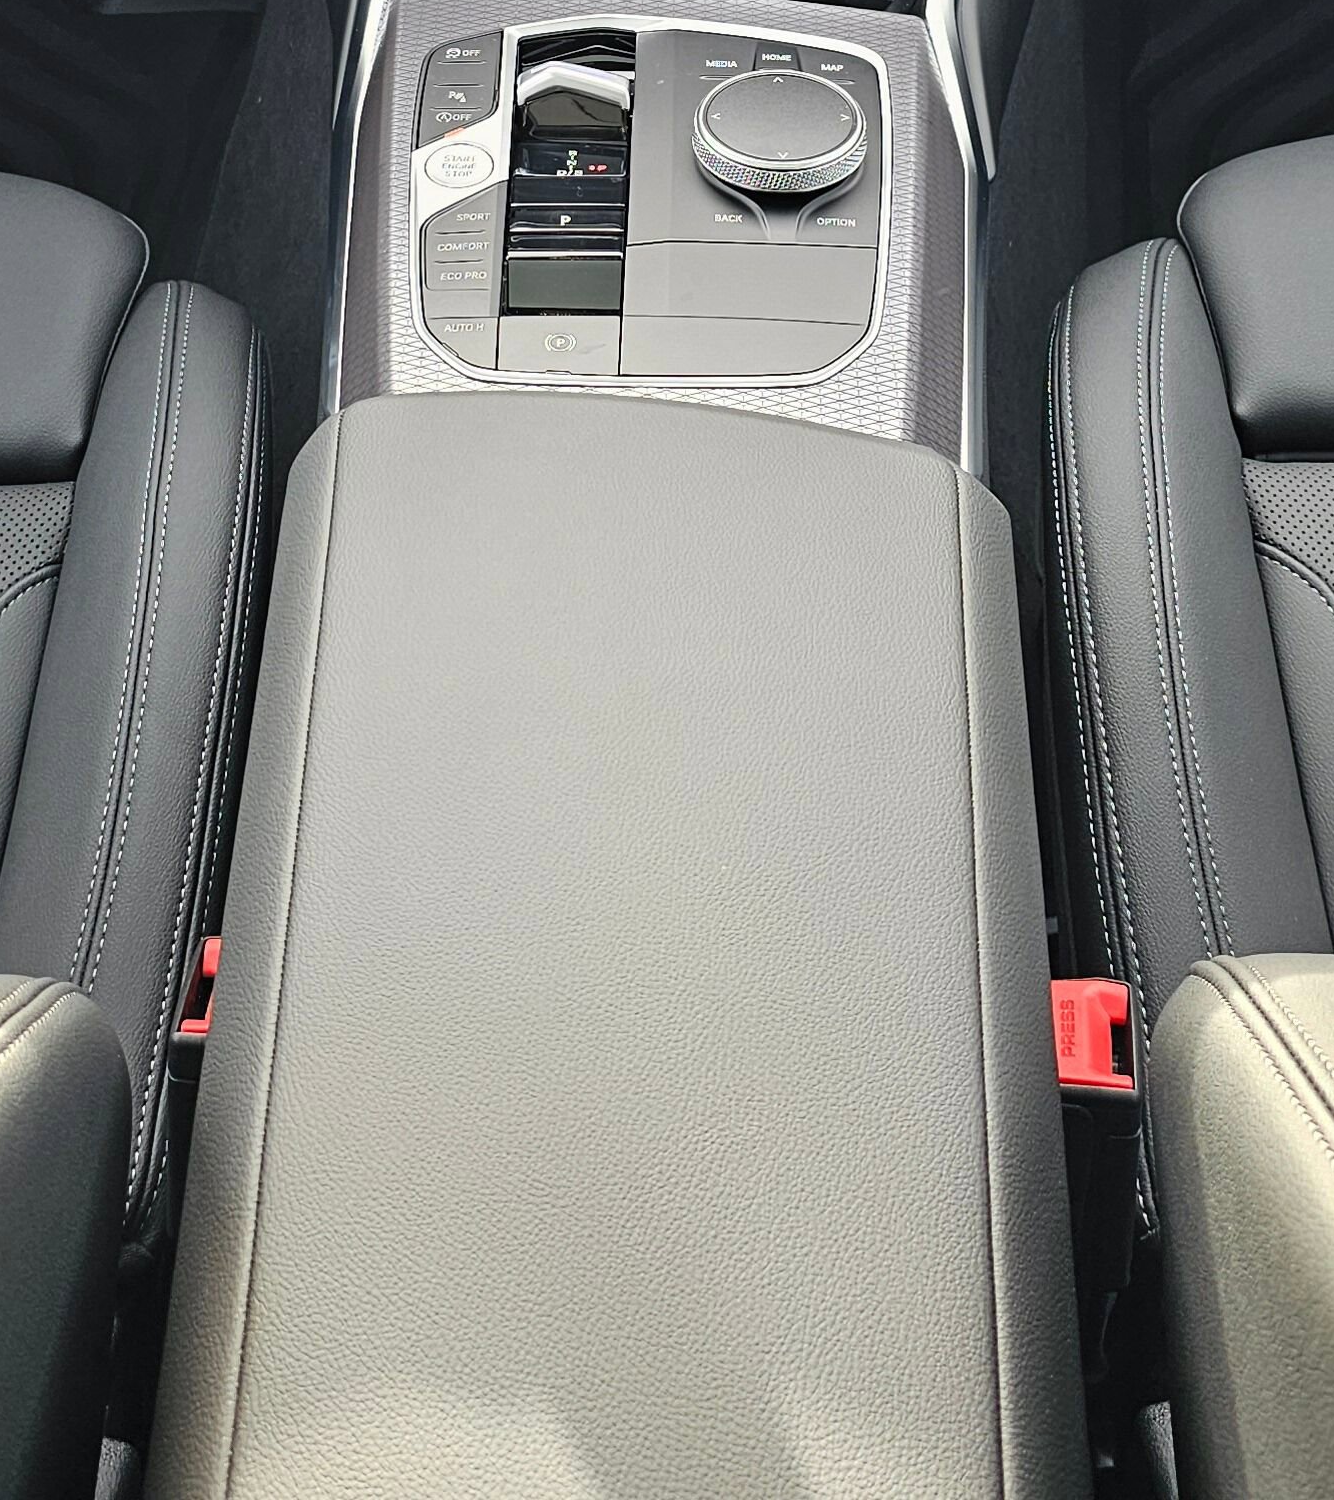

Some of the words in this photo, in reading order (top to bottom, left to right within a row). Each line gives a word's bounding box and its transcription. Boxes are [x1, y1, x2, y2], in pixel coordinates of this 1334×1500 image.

[462, 49, 481, 57] OFF
[761, 53, 792, 62] HOME
[705, 59, 738, 69] MEDIA
[820, 63, 844, 72] MAP
[452, 113, 472, 122] OFF
[456, 212, 491, 221] SPORT
[560, 214, 572, 226] P
[714, 213, 743, 223] BACK
[816, 217, 857, 227] OPTION
[437, 241, 491, 252] COMFORT
[440, 272, 463, 281] ECO
[464, 271, 488, 280] PRO
[444, 323, 473, 333] AUTO
[476, 323, 485, 332] H
[1059, 1000, 1076, 1058] PRESS
